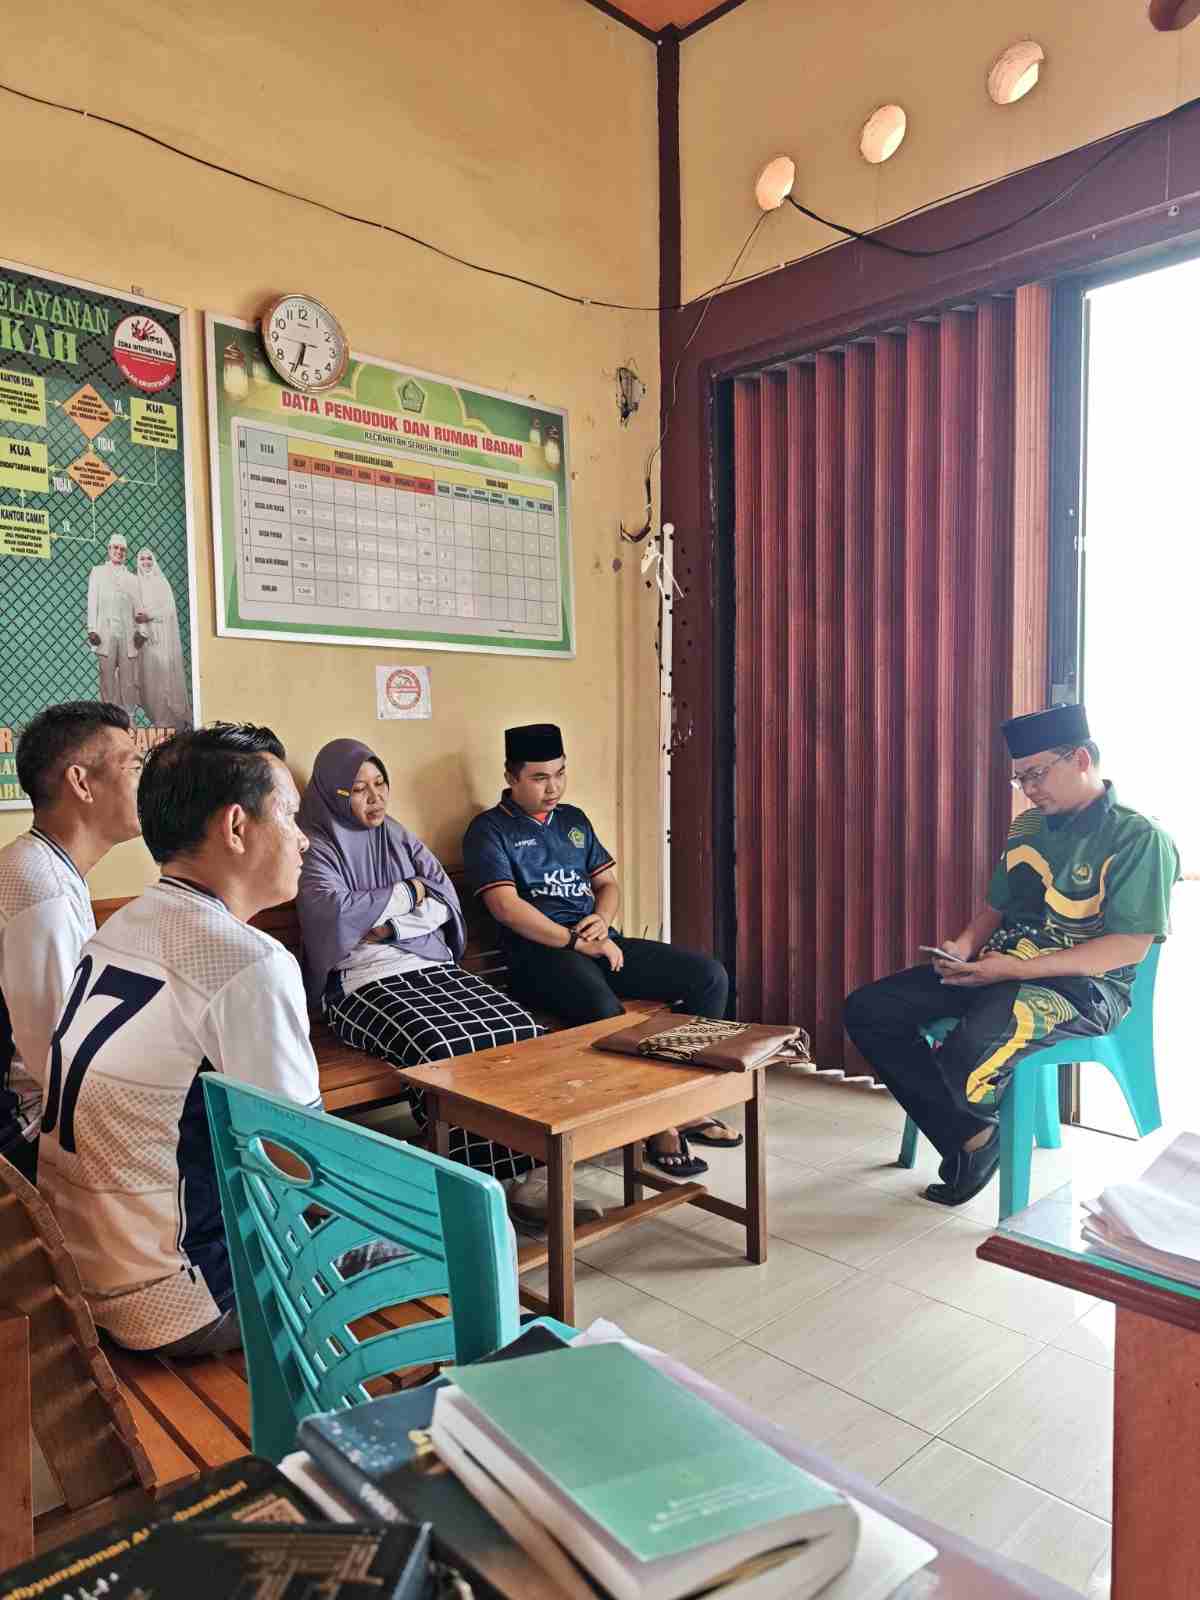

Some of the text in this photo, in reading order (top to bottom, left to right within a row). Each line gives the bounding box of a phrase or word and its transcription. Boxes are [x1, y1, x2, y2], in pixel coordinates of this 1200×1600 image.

[286, 309, 293, 320] 11
[298, 309, 308, 320] 12
[275, 318, 286, 330] 10
[315, 318, 319, 328] 1
[271, 331, 279, 342] 9
[324, 331, 331, 342] 2
[277, 348, 284, 360] 8
[329, 347, 336, 359] 3
[288, 361, 296, 373] 7
[324, 362, 332, 372] 4
[301, 370, 309, 381] 6
[314, 369, 322, 380] 5
[146, 402, 165, 415] KUA
[281, 391, 523, 458] DATA PENDUDUK DAN RUMAH IBADAH
[9, 443, 32, 457] KUA
[1, 508, 46, 525] KANTOR CAMAT
